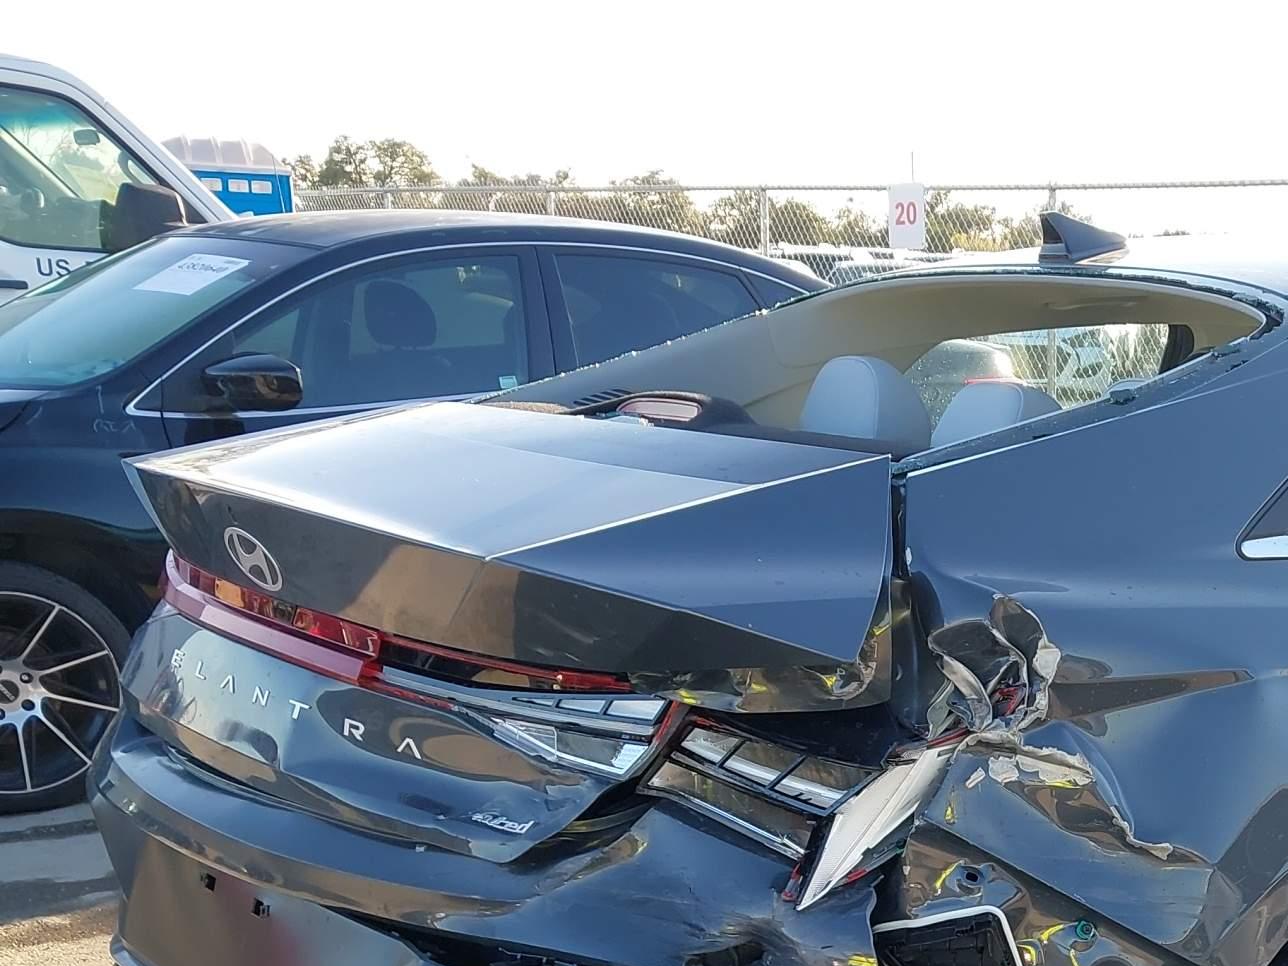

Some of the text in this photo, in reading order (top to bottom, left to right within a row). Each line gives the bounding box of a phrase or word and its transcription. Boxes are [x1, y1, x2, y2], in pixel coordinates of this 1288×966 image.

[894, 200, 918, 226] 20
[35, 256, 72, 277] US
[170, 648, 422, 760] ELANTRA
